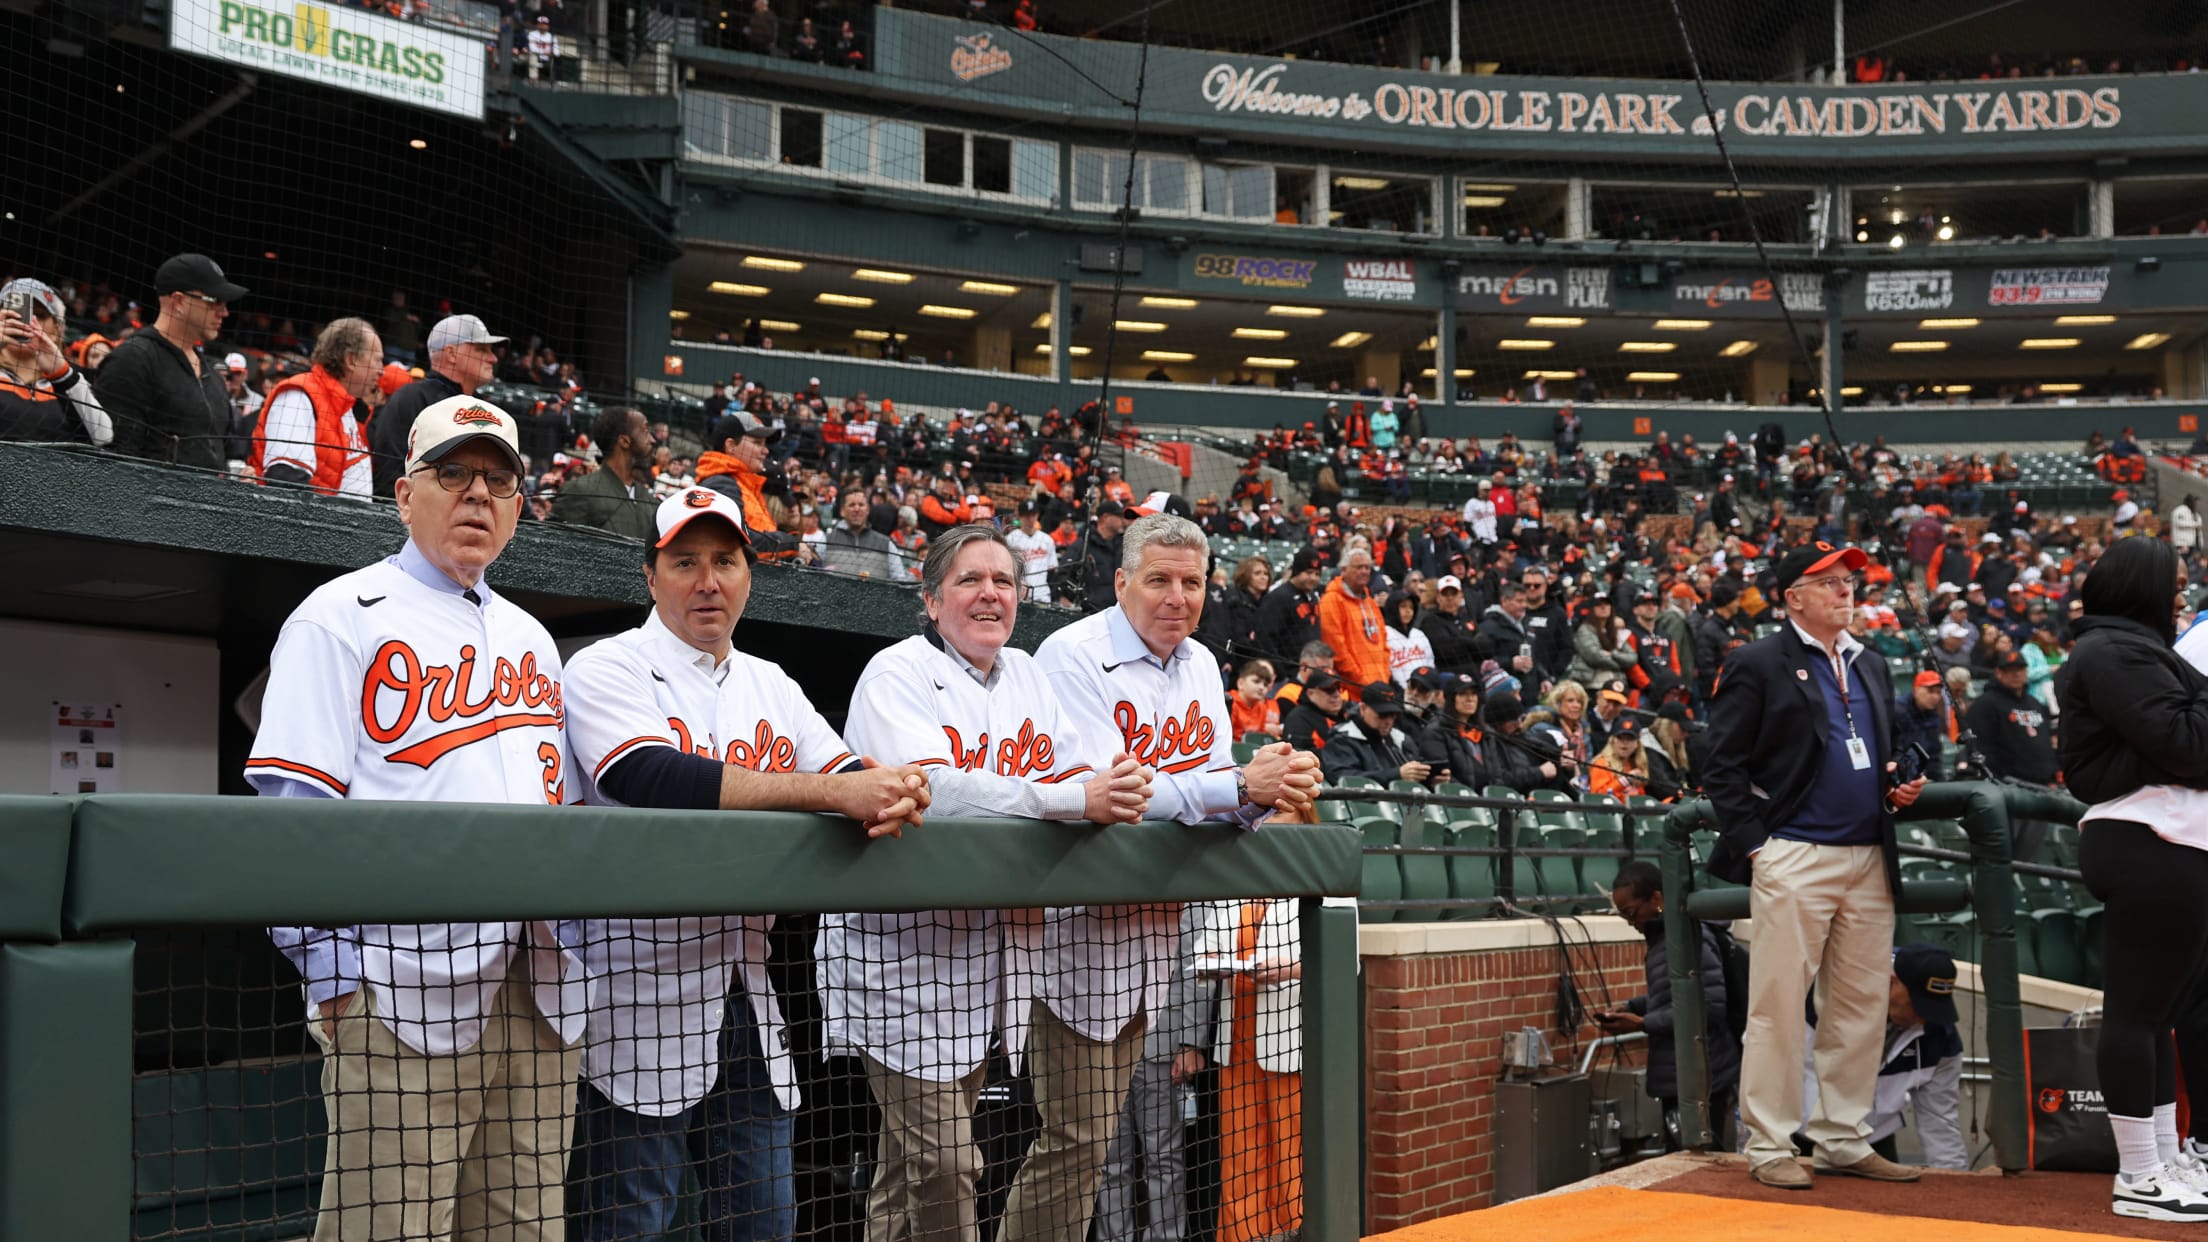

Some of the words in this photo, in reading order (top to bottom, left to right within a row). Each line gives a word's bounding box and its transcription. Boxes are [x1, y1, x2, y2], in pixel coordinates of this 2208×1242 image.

[219, 0, 293, 48] PRO
[331, 28, 446, 85] GRASS
[216, 38, 268, 61] LOCAL
[272, 51, 315, 71] LAWN
[320, 62, 361, 85] CARE
[364, 72, 408, 94] SINCE
[1201, 63, 1341, 117] Welcome
[1342, 92, 1373, 121] to
[1374, 82, 1553, 132] ORIOLE
[1556, 92, 1686, 135] PARK
[1690, 108, 1727, 136] at
[1733, 94, 1949, 138] CAMDEN
[1951, 87, 2122, 132] YARDS
[1345, 260, 1413, 280] WBAL
[1458, 272, 1559, 298] masn
[1866, 270, 1953, 293] ESPN
[1991, 268, 2110, 285] NEWSTALK
[1990, 286, 2042, 304] 93.9
[361, 639, 565, 745] Orioles
[1114, 700, 1215, 768] Oriole
